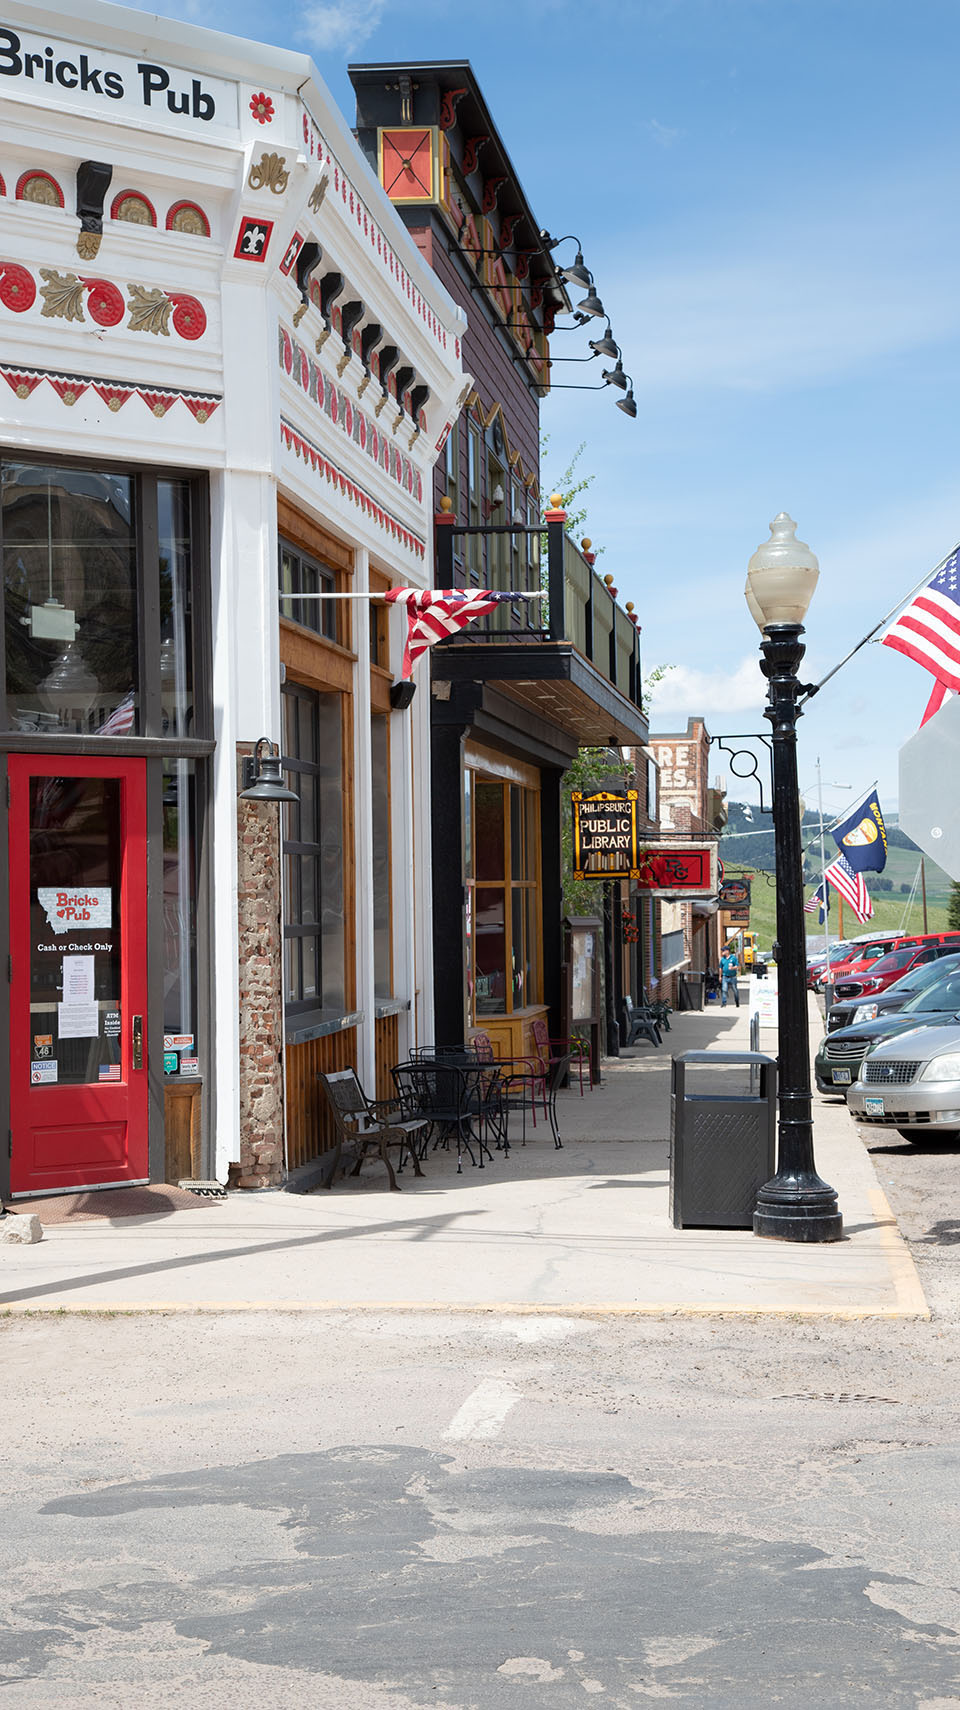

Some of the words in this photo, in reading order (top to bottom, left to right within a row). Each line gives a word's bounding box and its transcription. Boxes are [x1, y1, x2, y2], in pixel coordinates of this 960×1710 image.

[0, 28, 125, 99] Bricks
[137, 63, 216, 121] Pub
[579, 802, 632, 816] PHILIPSBURG
[580, 819, 630, 833] PUBLIC
[582, 836, 631, 849] LIBRARY
[56, 892, 99, 907] Bricks
[65, 907, 91, 921] Pub
[37, 943, 57, 952] Cash
[68, 943, 93, 951] Check
[94, 943, 113, 952] Only
[33, 1062, 56, 1070] NOTICE
